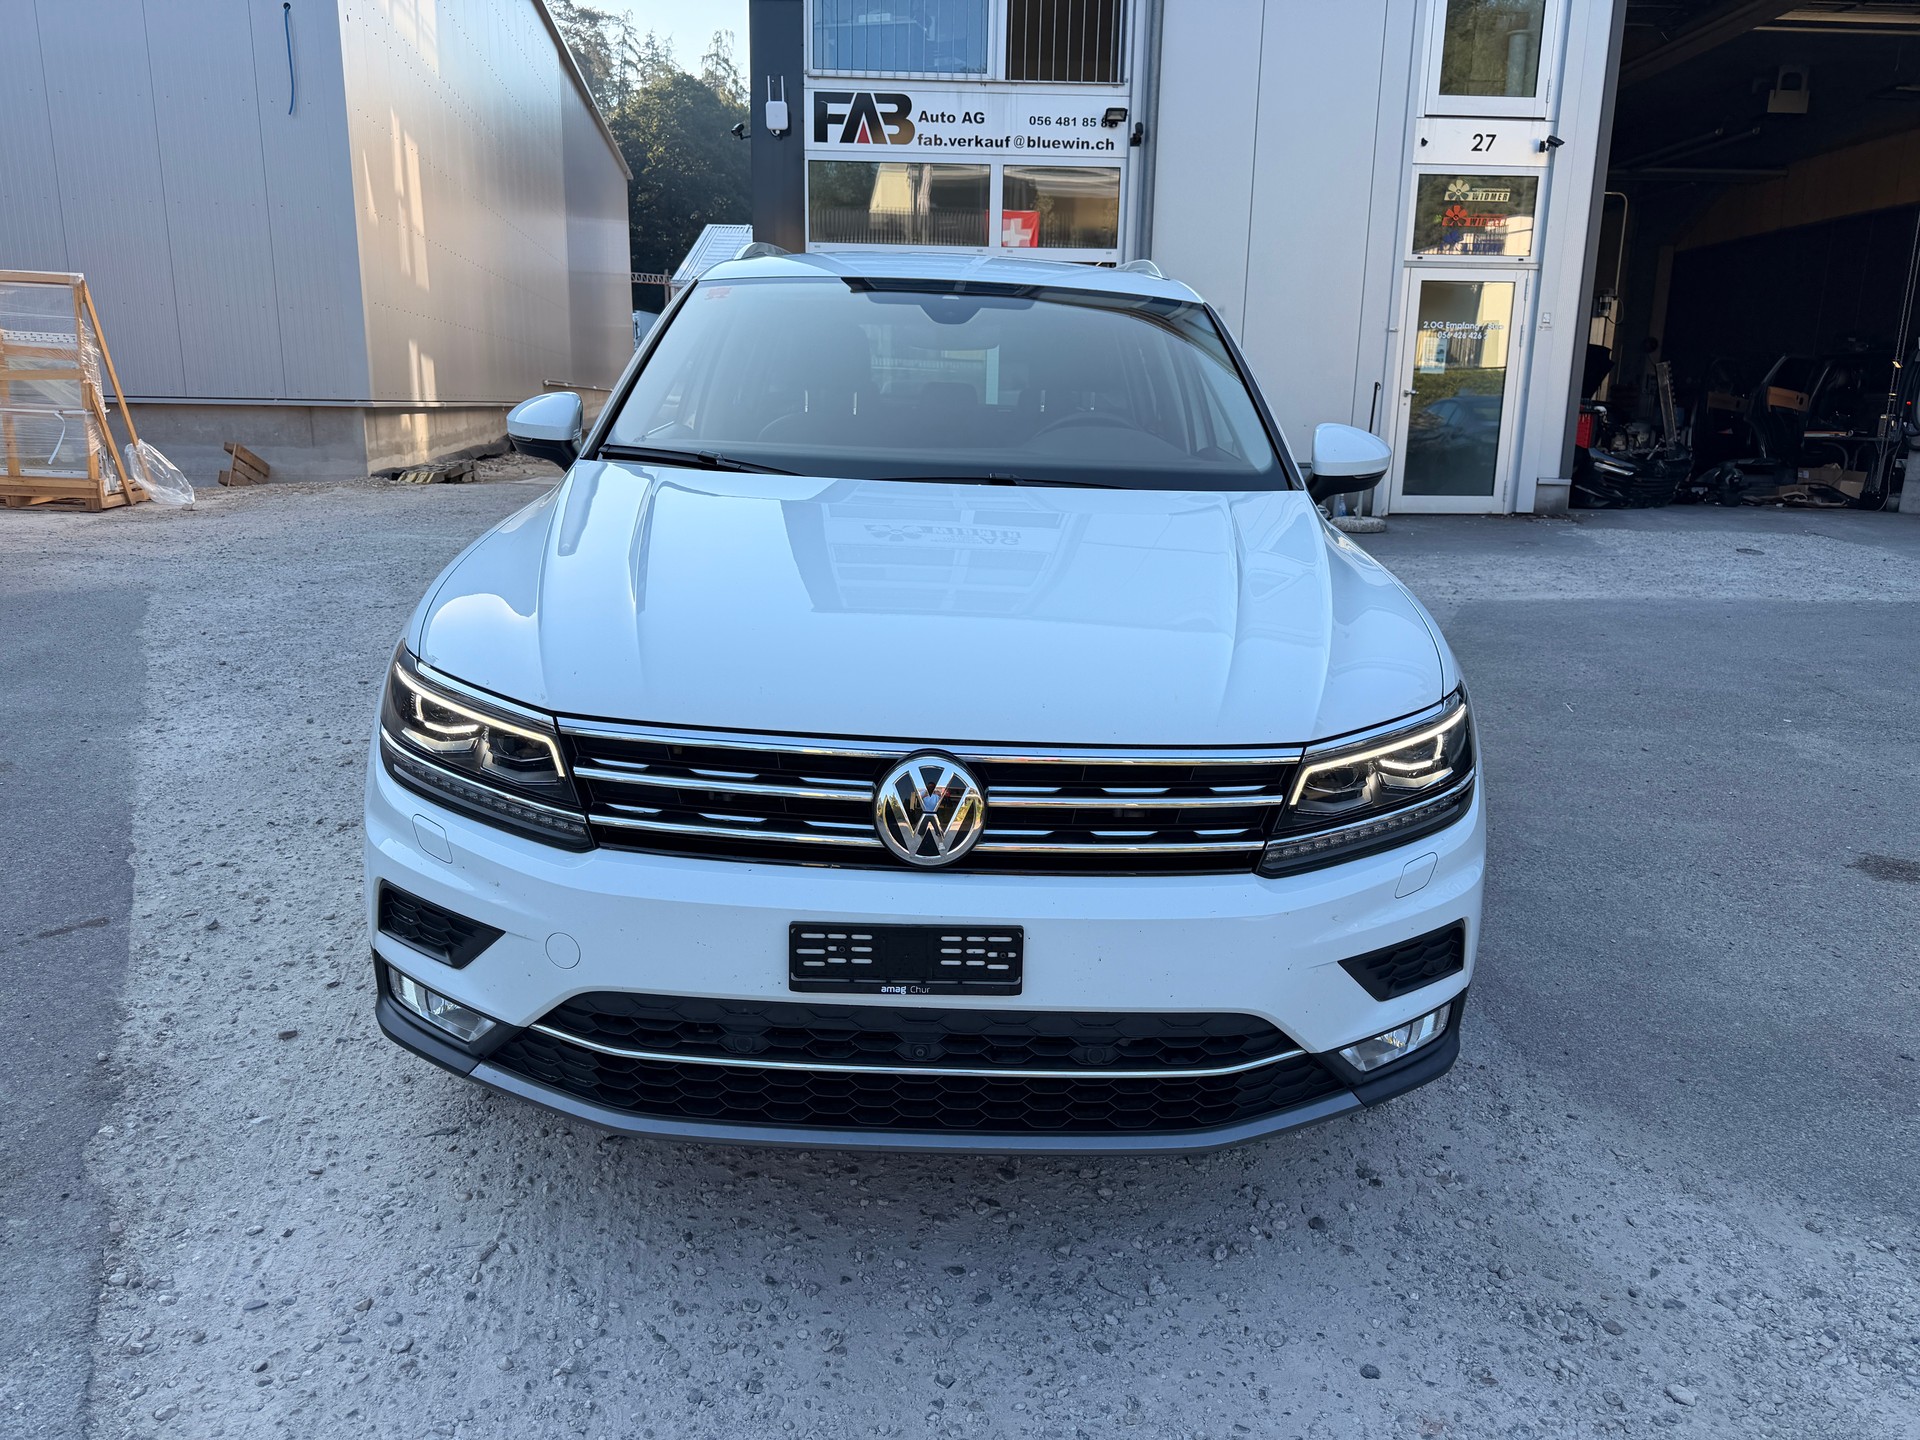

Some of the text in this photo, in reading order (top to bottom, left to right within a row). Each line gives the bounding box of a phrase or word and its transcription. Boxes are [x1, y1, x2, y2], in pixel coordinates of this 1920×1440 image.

[814, 91, 916, 145] FAB
[918, 110, 985, 125] Auto AG
[1029, 115, 1052, 126] 056
[1055, 116, 1077, 127] 481
[1082, 117, 1097, 127] 85
[1470, 133, 1497, 152] 27
[1472, 192, 1508, 201] WIDMER
[881, 985, 931, 995] amag Chur
